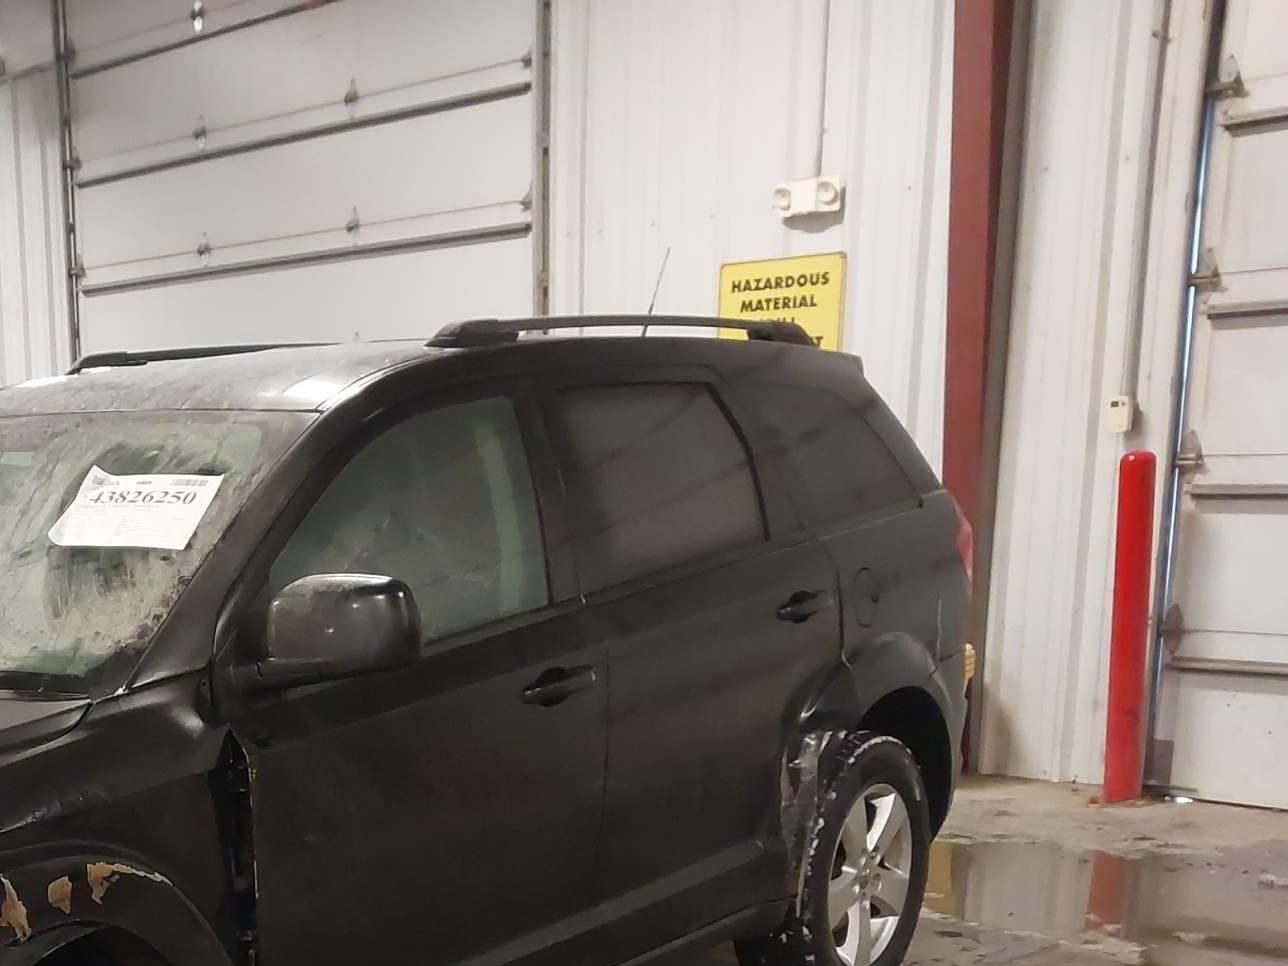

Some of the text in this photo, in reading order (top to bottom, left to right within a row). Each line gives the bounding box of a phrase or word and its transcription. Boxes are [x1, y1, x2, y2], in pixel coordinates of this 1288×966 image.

[731, 271, 830, 294] HAZARDOUS
[740, 294, 818, 313] MATERIAL
[90, 490, 197, 504] 43826250
